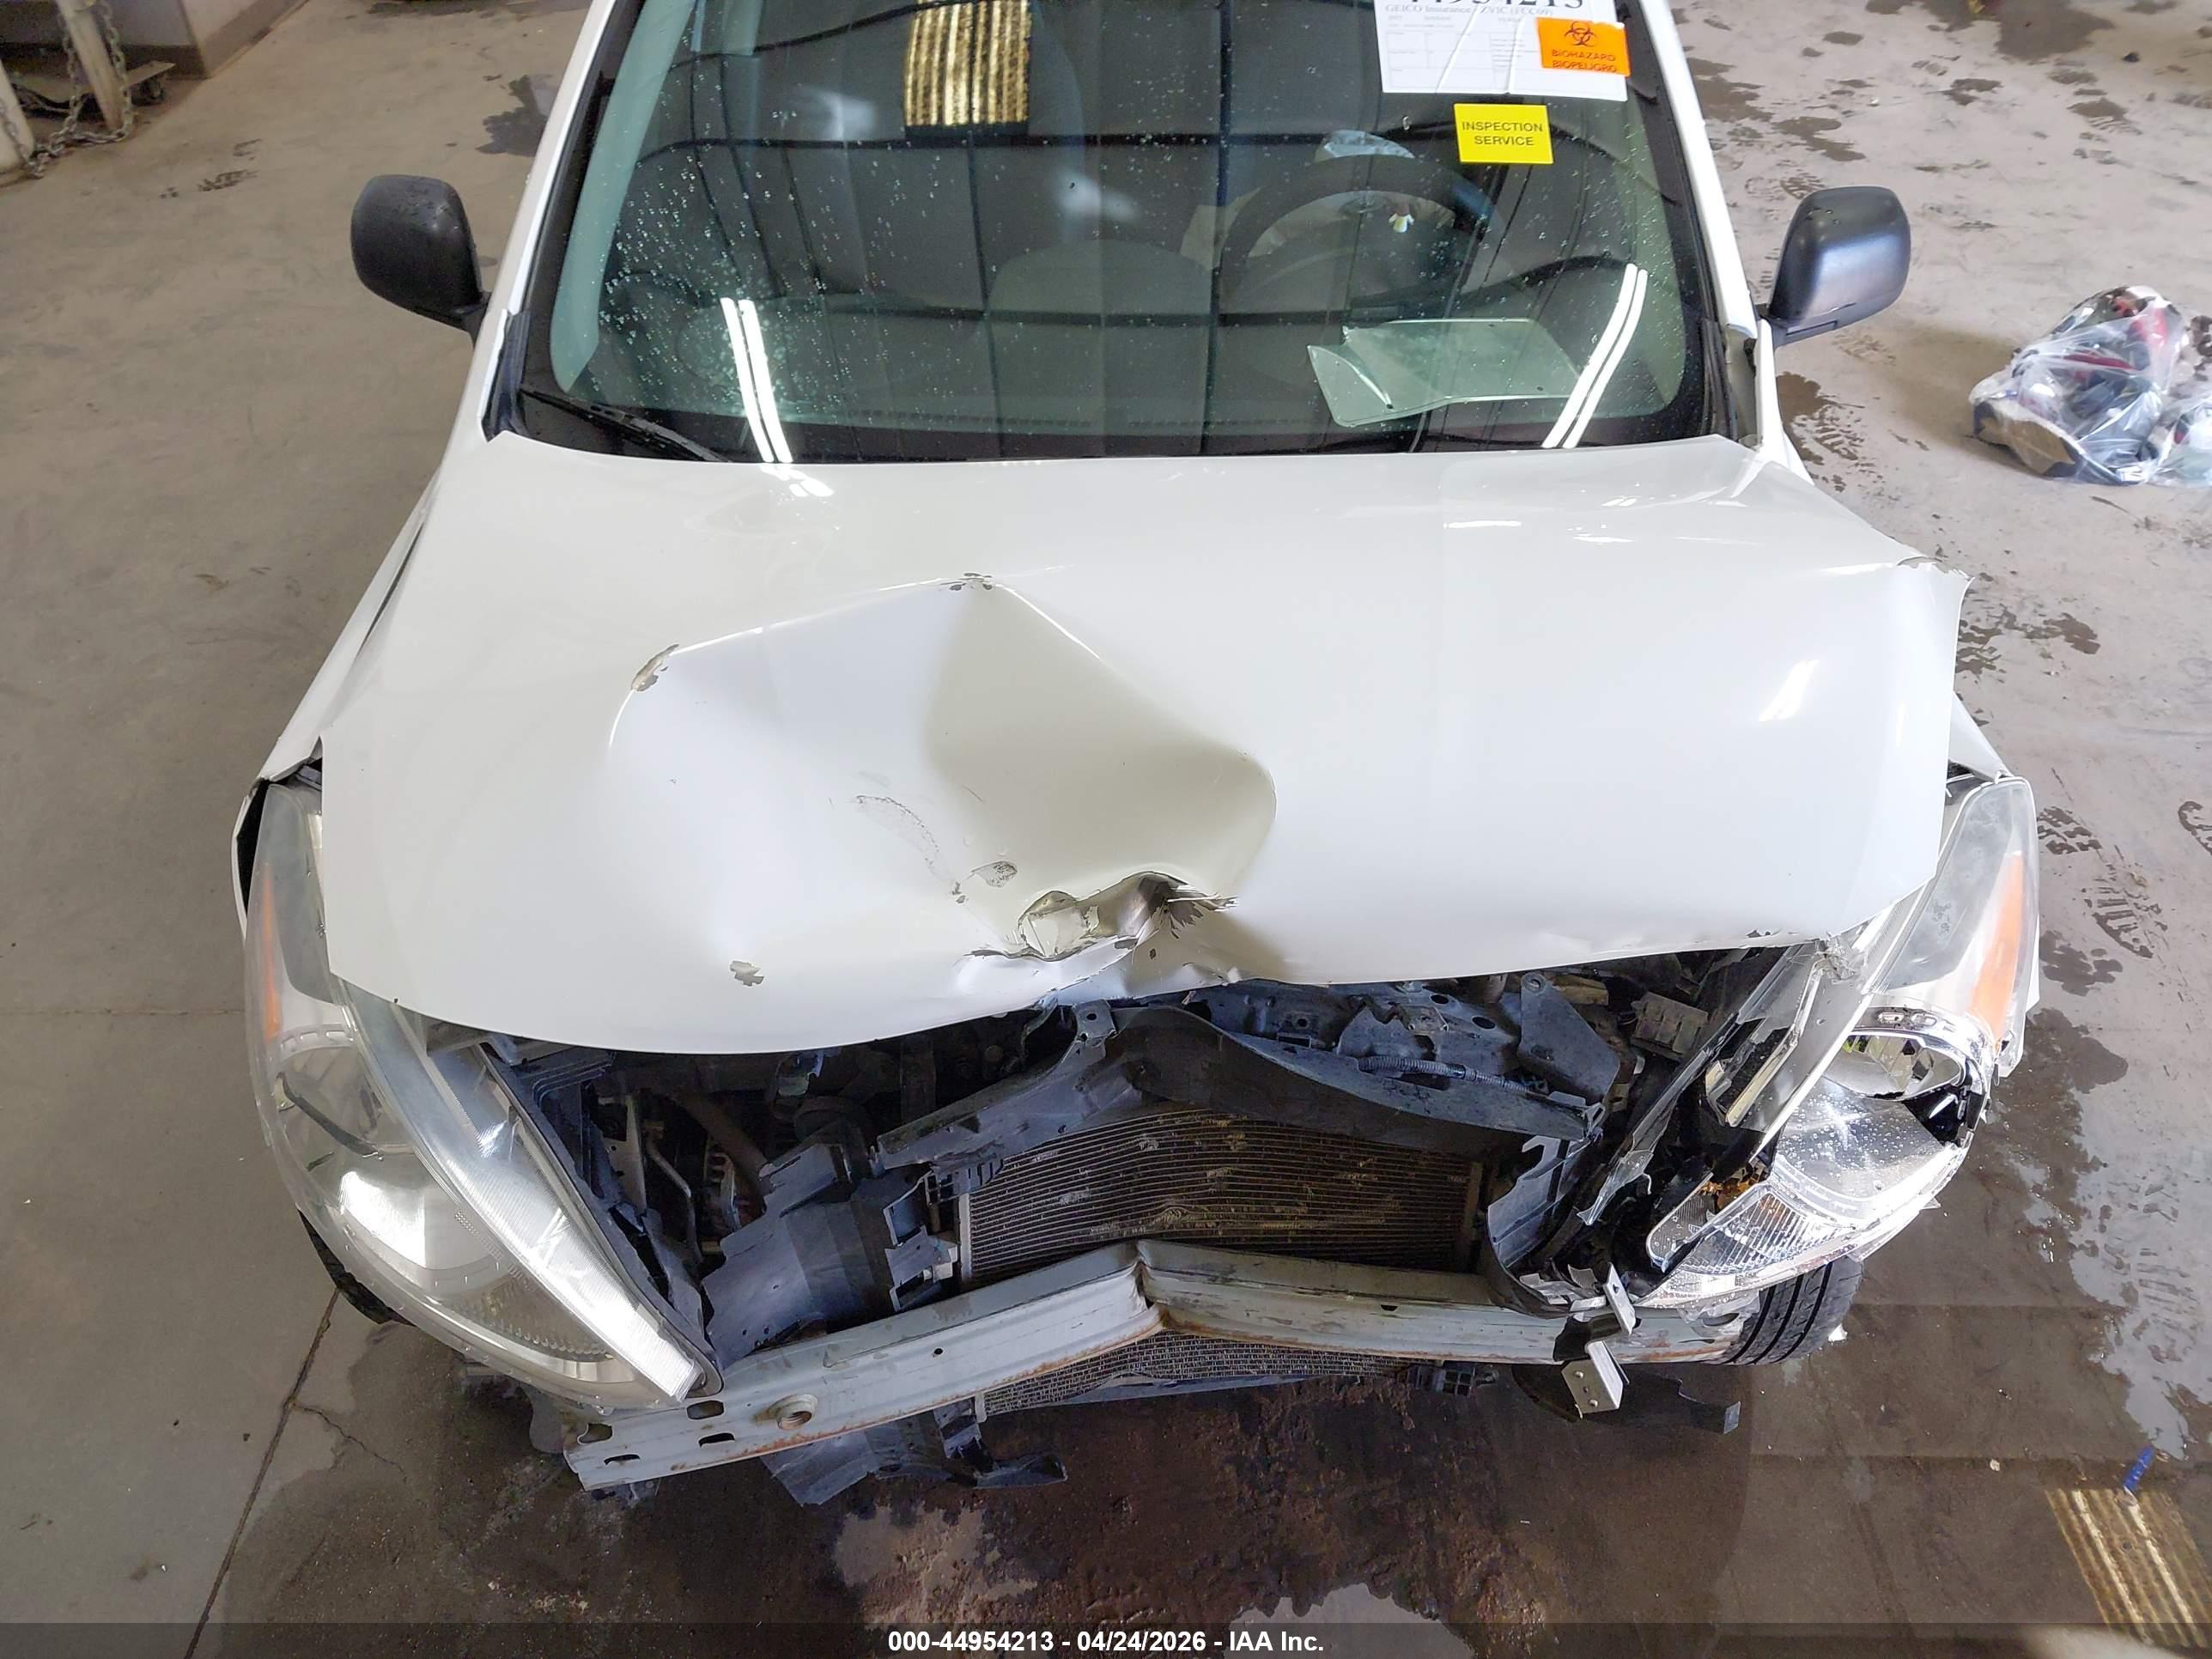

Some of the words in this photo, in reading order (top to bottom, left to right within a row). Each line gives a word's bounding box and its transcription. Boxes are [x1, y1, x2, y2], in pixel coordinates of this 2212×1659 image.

[1385, 3, 1423, 13] GEICO
[1425, 5, 1471, 14] Insurance
[1552, 49, 1616, 61] BIOHAZARD
[1552, 59, 1617, 72] BIOPELIGRO
[1462, 121, 1543, 132] INSPECTION
[1474, 135, 1534, 146] SERVICE
